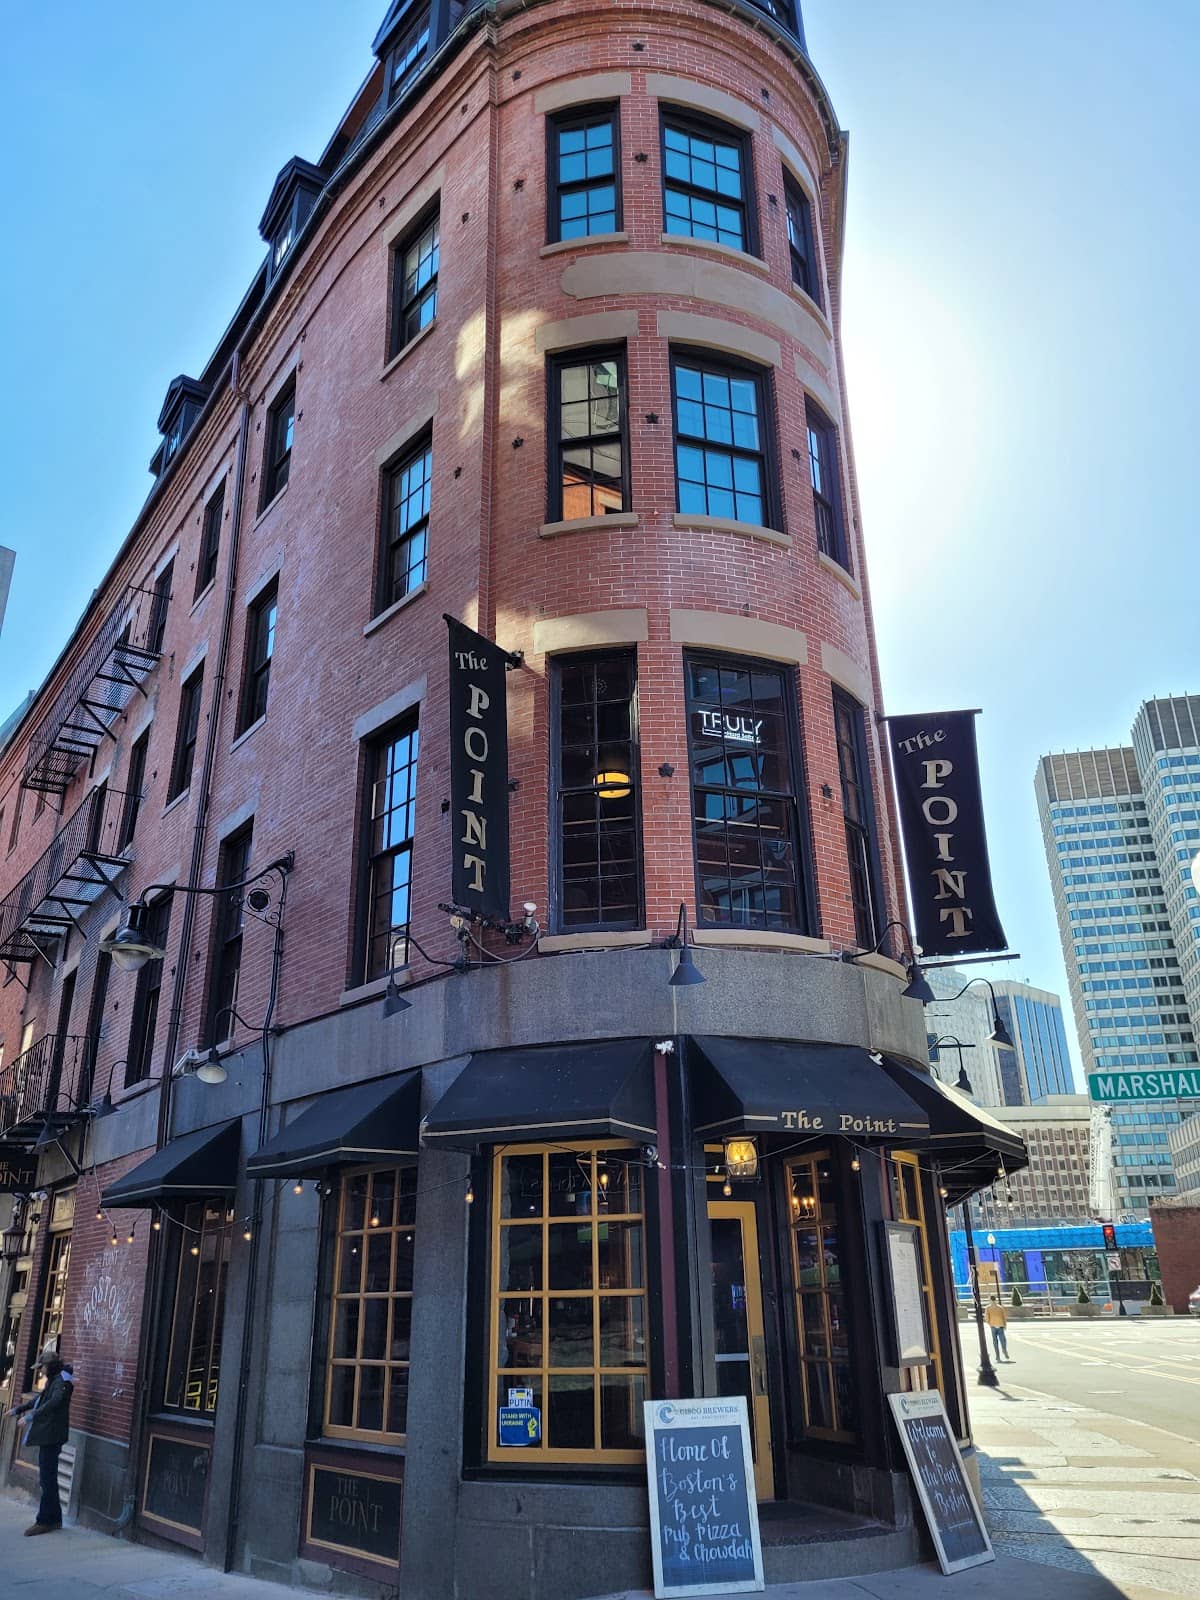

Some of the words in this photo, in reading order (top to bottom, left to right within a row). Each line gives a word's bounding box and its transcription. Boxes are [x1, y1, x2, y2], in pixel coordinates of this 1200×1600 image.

[455, 650, 489, 671] The
[698, 710, 762, 735] TRULY
[898, 728, 948, 756] The
[460, 683, 490, 893] POINT
[920, 759, 975, 938] POINT
[781, 1109, 824, 1130] The
[839, 1114, 897, 1133] Point
[510, 1399, 533, 1408] PUTIN
[660, 1436, 709, 1462] Home
[336, 1477, 359, 1496] THE
[658, 1467, 738, 1502] Boston's
[330, 1491, 383, 1535] POINT
[672, 1494, 721, 1523] Best
